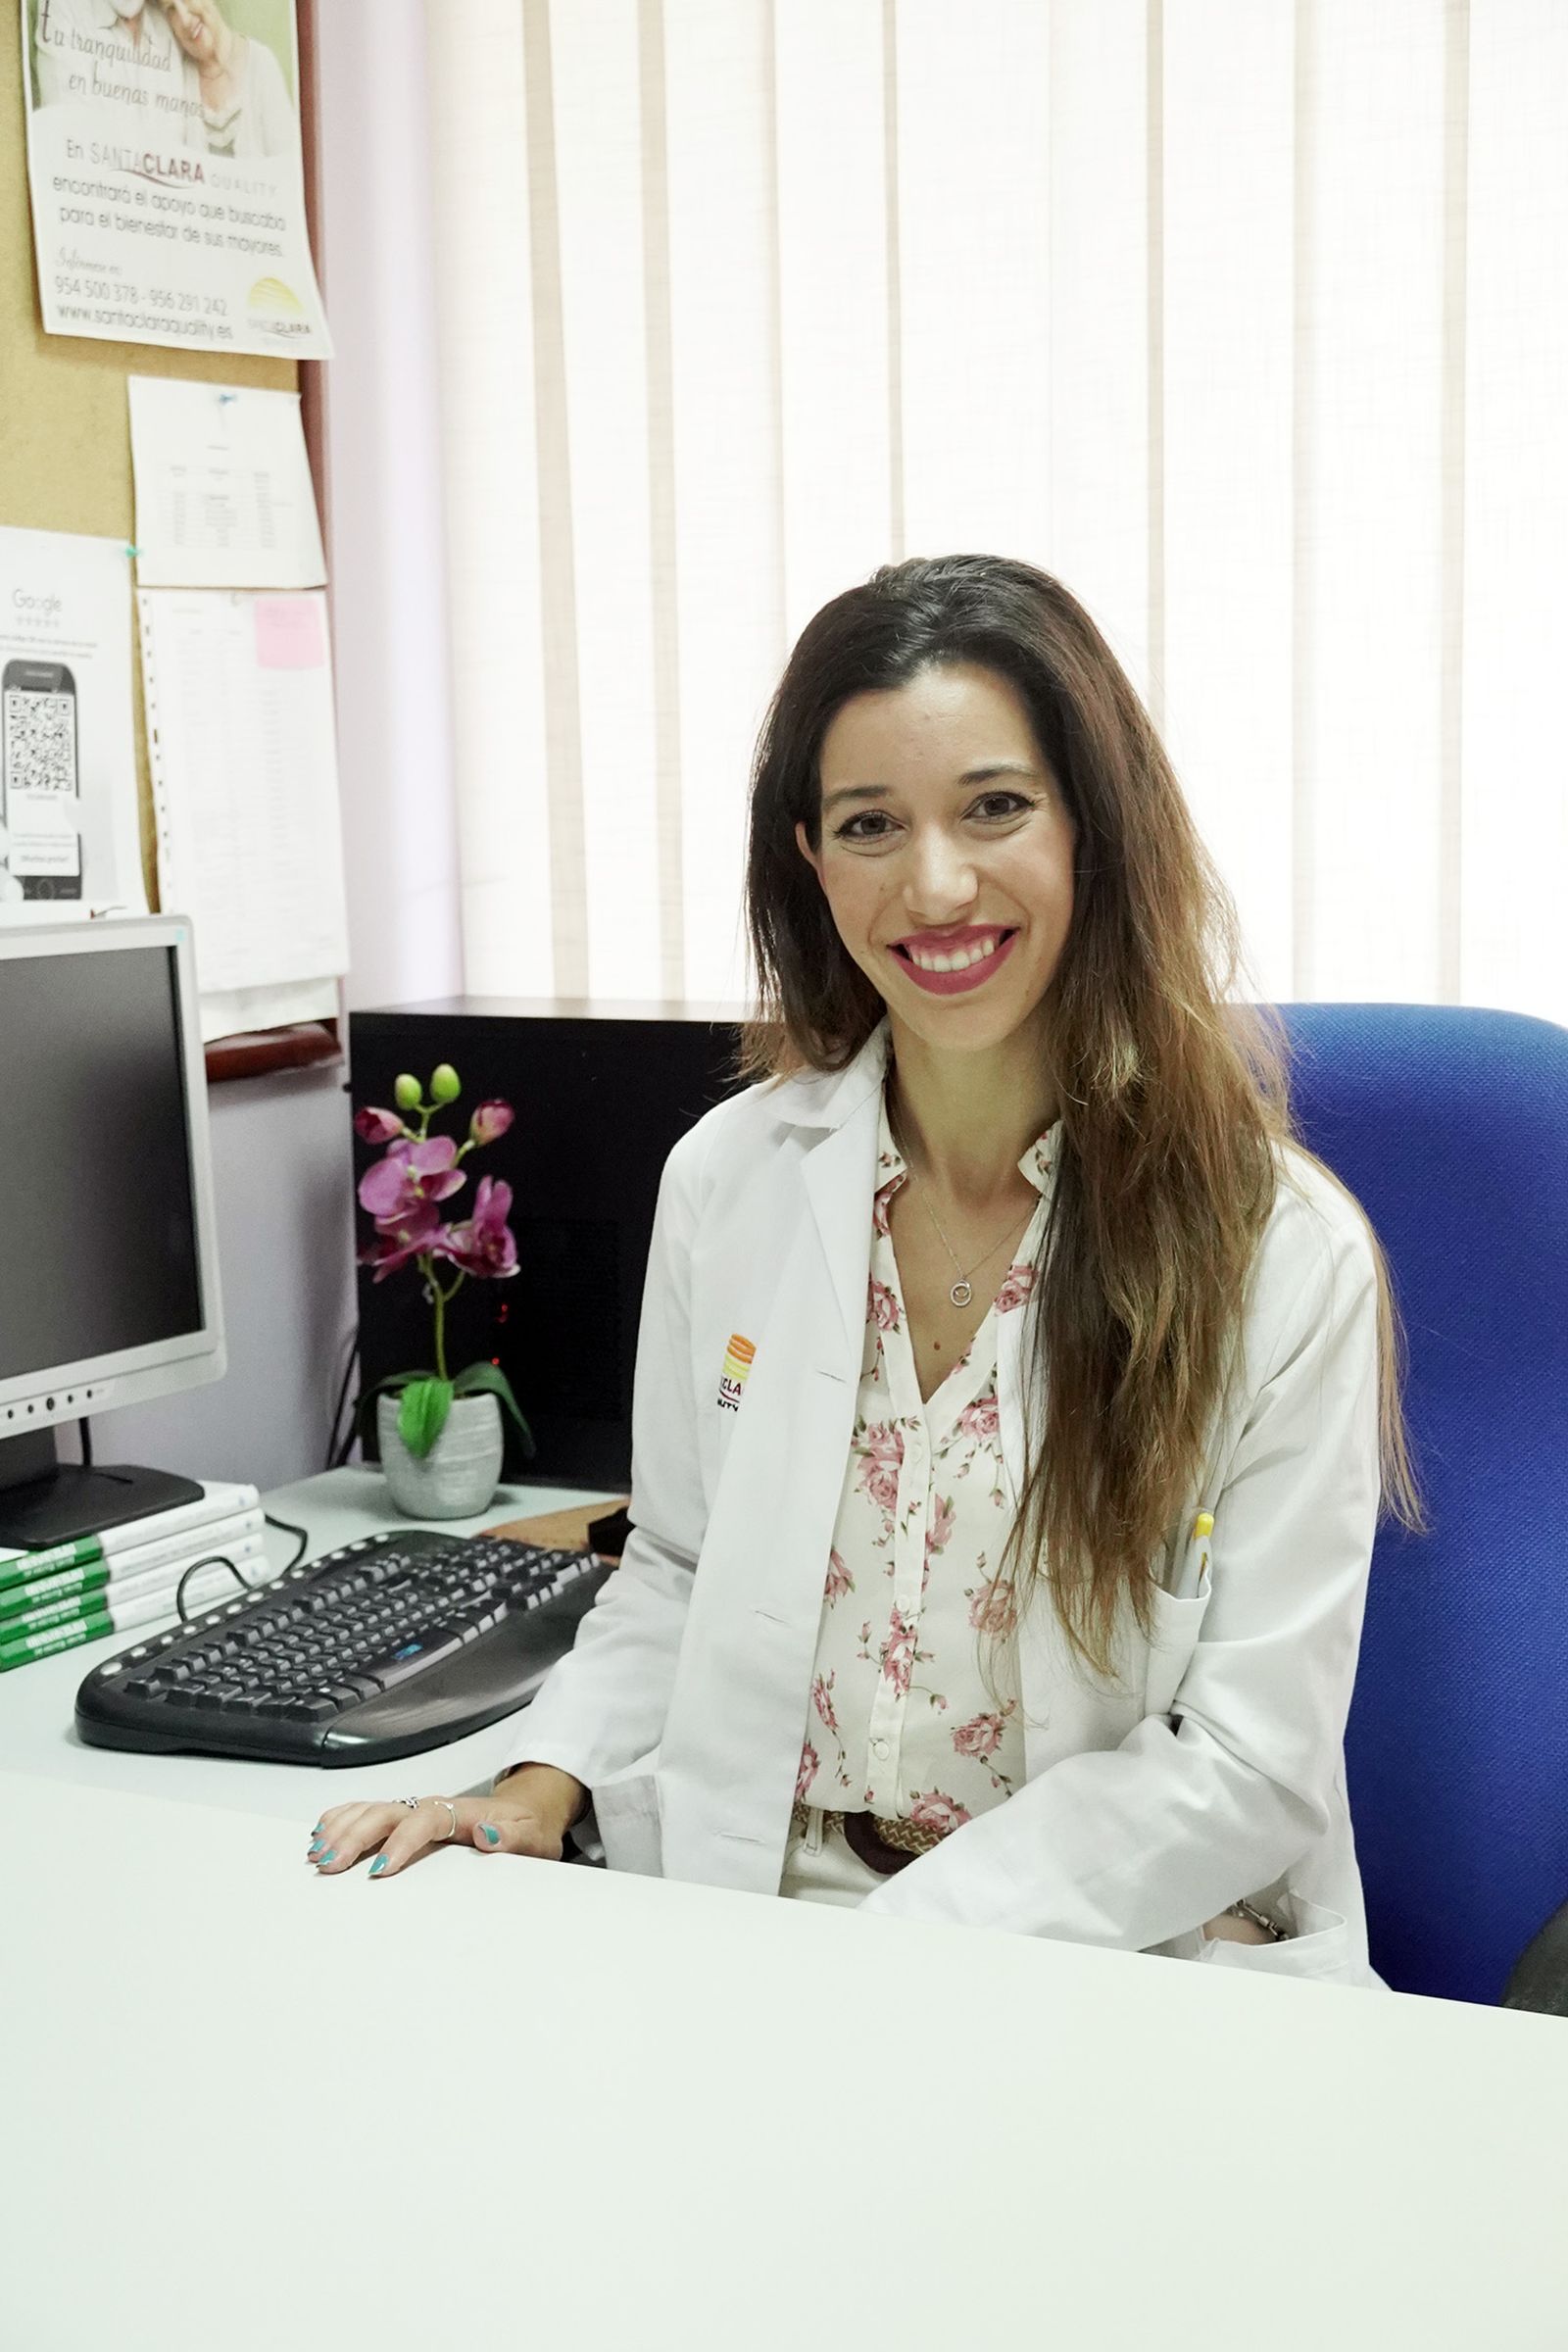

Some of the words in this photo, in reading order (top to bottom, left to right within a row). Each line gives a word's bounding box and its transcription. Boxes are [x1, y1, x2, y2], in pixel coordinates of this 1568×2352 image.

[71, 26, 172, 73] tranquilidad
[69, 74, 87, 96] en
[92, 60, 149, 107] buenas
[156, 93, 206, 119] manos
[66, 138, 84, 160] En
[89, 141, 205, 184] SANTACLARA
[53, 175, 132, 205] encontrará
[135, 188, 147, 206] el
[151, 194, 197, 218] apoyo
[199, 202, 225, 222] que
[228, 204, 287, 231] buscaba
[59, 206, 96, 227] para
[99, 211, 112, 229] el
[116, 212, 178, 241] bienestar
[182, 221, 201, 244] de
[204, 229, 224, 249] sus
[55, 274, 80, 296] 954
[84, 279, 111, 301] 500
[113, 282, 139, 306] 378
[57, 304, 235, 342] www.santaclaraquality.es
